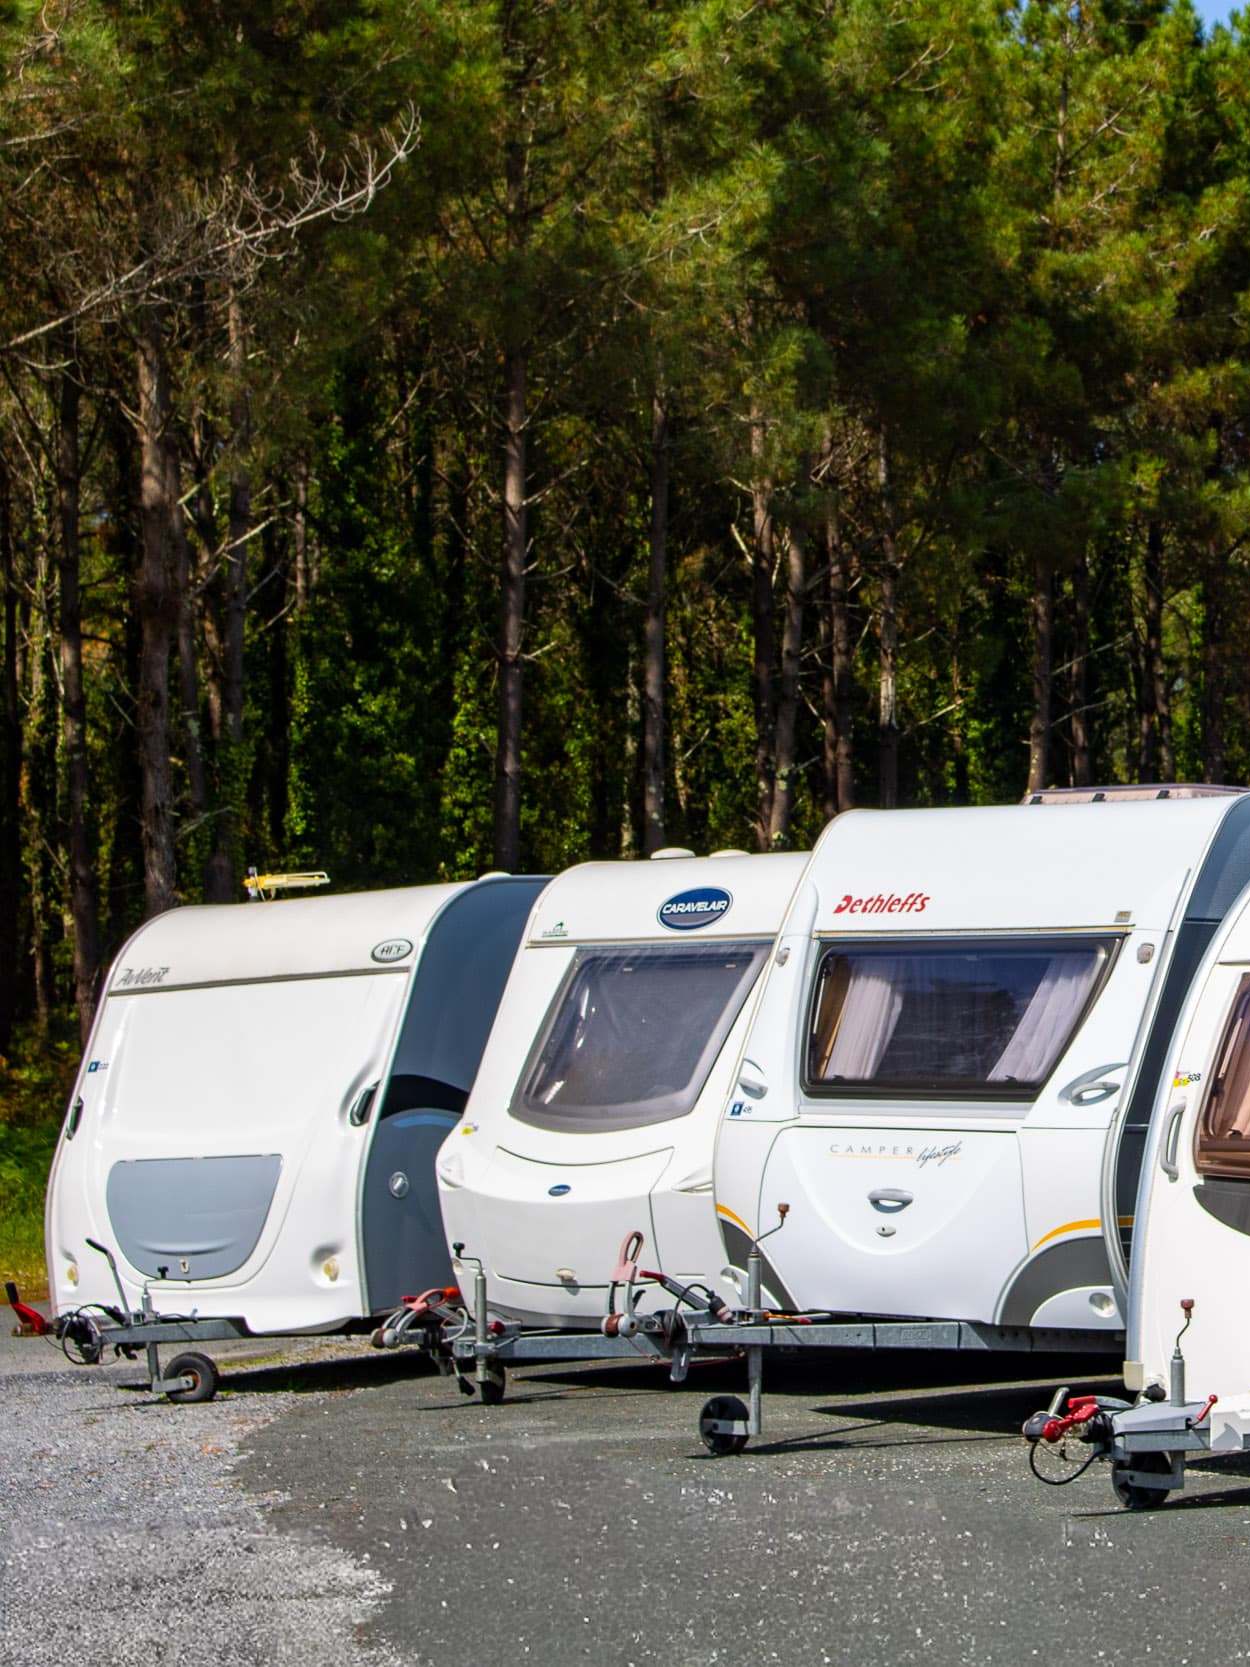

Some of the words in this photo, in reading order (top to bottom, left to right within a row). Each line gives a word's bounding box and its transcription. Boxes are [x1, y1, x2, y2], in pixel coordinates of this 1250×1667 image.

[662, 900, 728, 914] CARAVELAIR
[832, 892, 931, 914] Dethleffs
[829, 1144, 914, 1155] CAMPER
